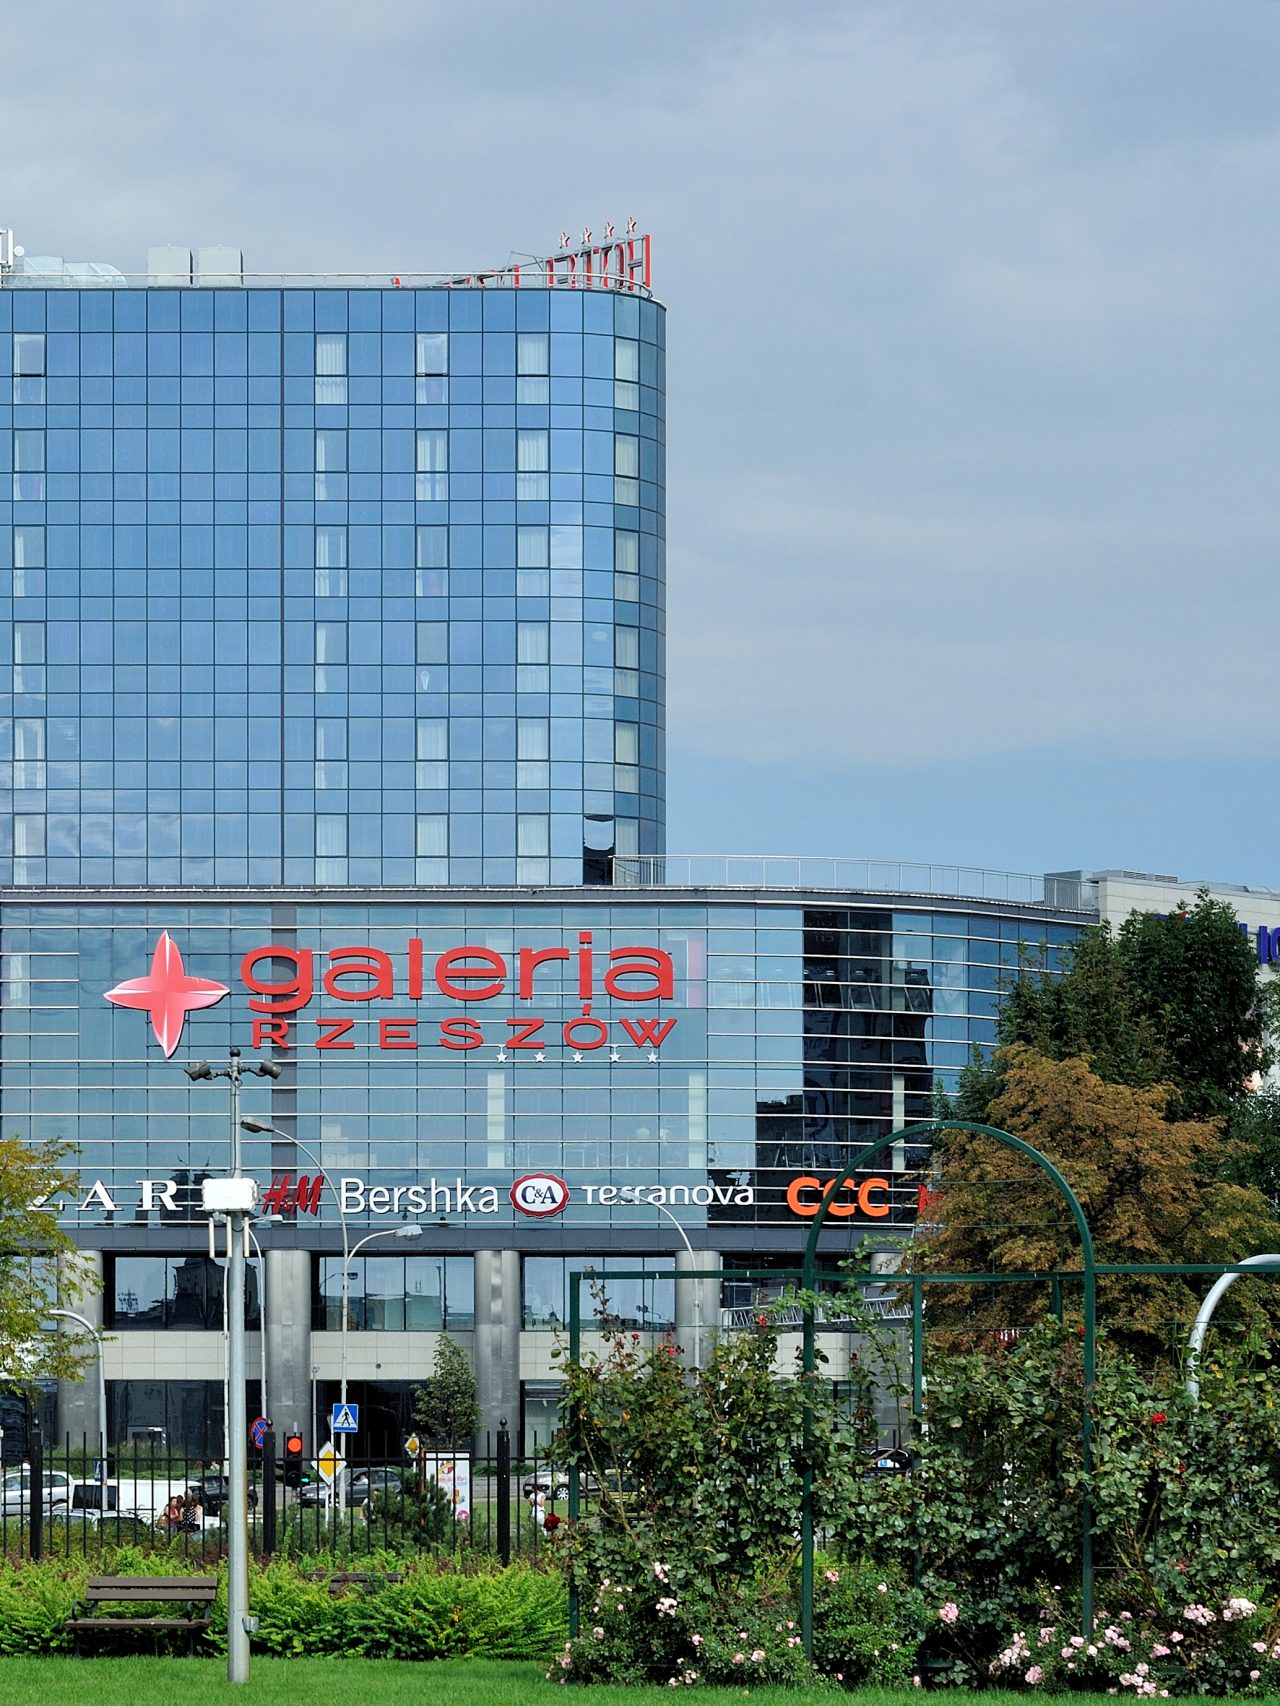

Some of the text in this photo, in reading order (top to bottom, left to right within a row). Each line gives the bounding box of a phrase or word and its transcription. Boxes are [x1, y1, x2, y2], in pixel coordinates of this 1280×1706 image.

[241, 931, 674, 1013] galeria
[252, 1003, 677, 1050] RZESZÓW
[26, 1179, 206, 1211] ZAR
[261, 1174, 324, 1216] H&M
[341, 1178, 500, 1215] Bershka
[521, 1184, 559, 1205] C&A
[787, 1176, 889, 1216] CCC
